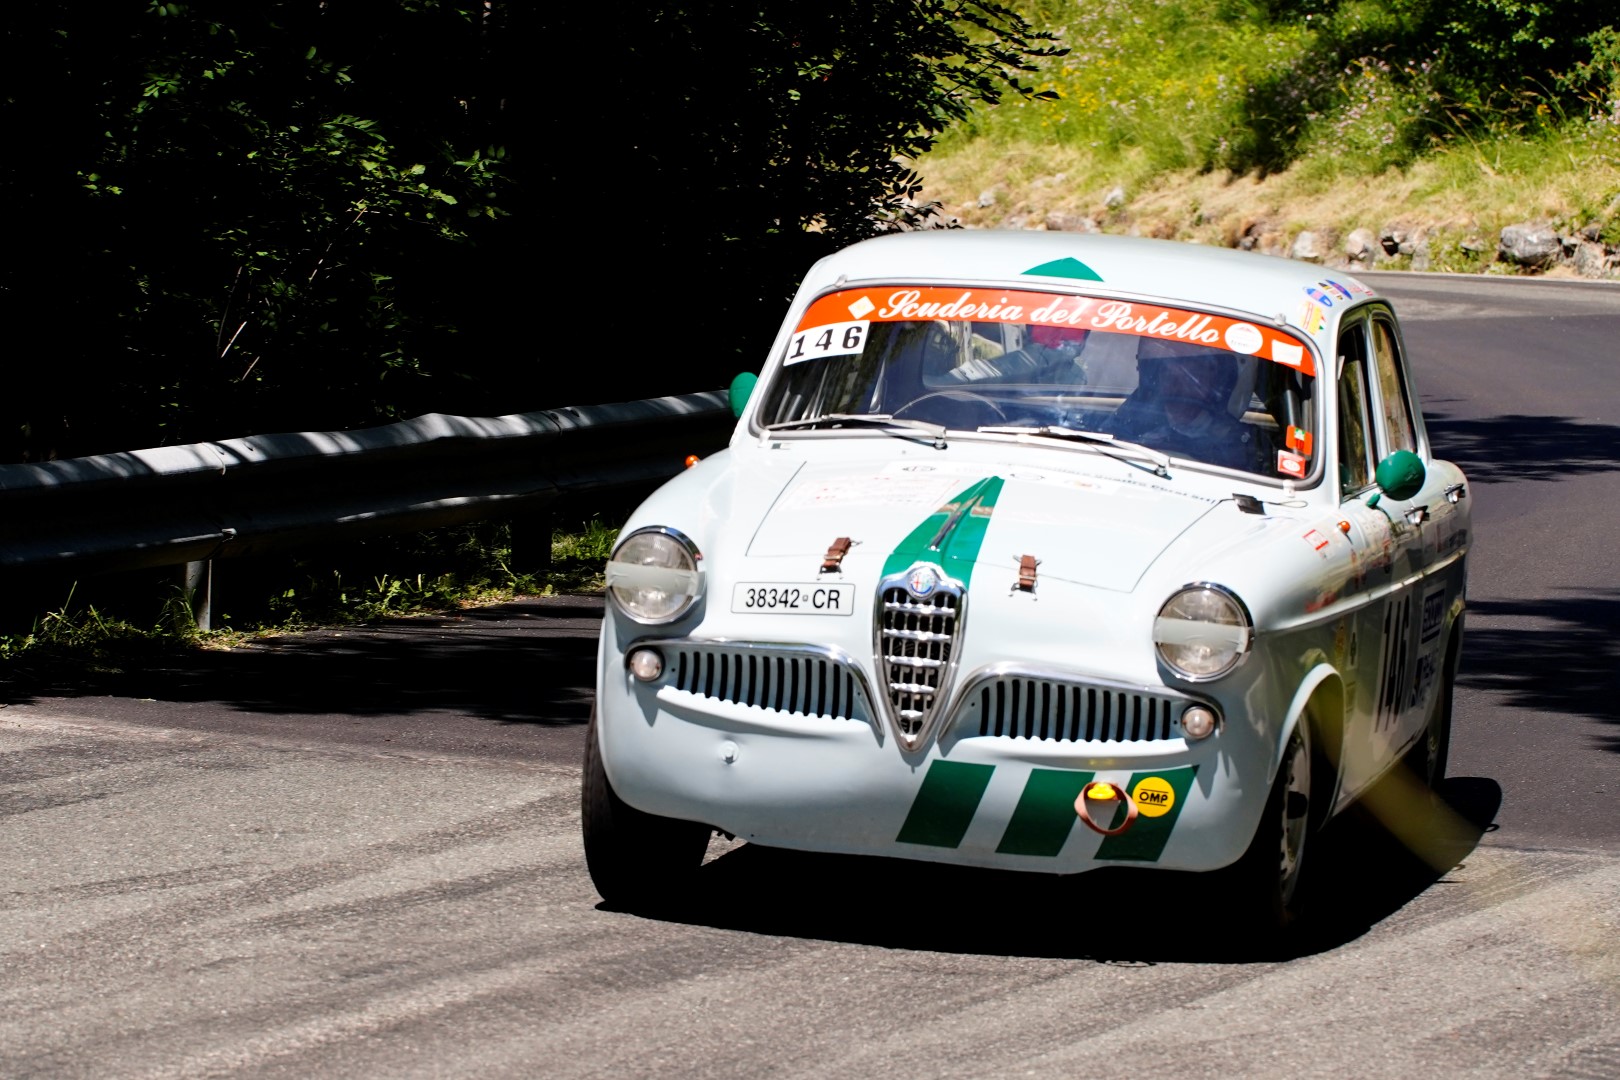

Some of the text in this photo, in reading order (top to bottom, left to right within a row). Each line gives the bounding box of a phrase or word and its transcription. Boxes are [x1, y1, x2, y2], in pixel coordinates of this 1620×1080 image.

[878, 290, 1220, 344] Scuderia del Portello
[789, 325, 863, 360] 146
[745, 587, 840, 610] 38342 CR
[1138, 791, 1169, 804] OMP
